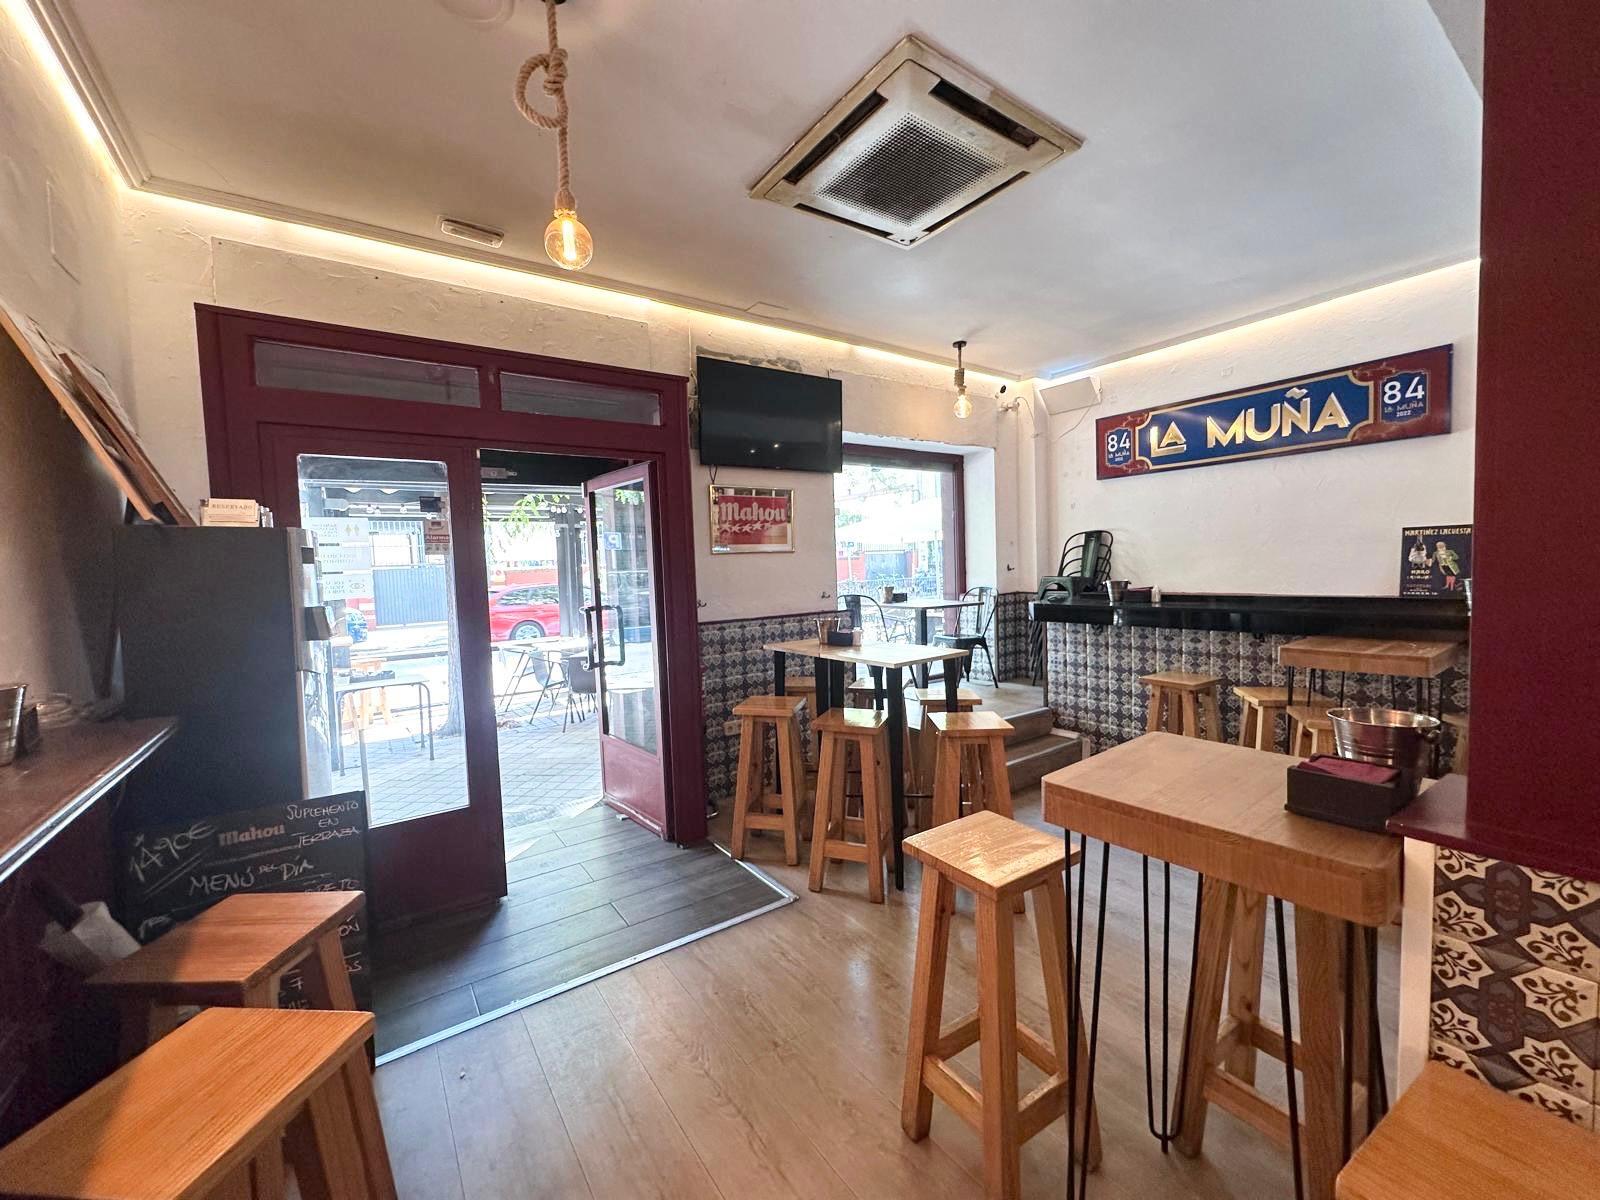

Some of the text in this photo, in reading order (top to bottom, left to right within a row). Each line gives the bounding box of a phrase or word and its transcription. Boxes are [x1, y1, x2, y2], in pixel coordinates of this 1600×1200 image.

[1383, 376, 1425, 404] 84
[1397, 401, 1423, 410] MUÑA
[1149, 388, 1351, 457] LA MUÑA
[1108, 432, 1130, 452] 84
[719, 502, 787, 522] Mahou
[286, 800, 359, 820] SUPLEMENTO
[217, 823, 286, 847] Mahou
